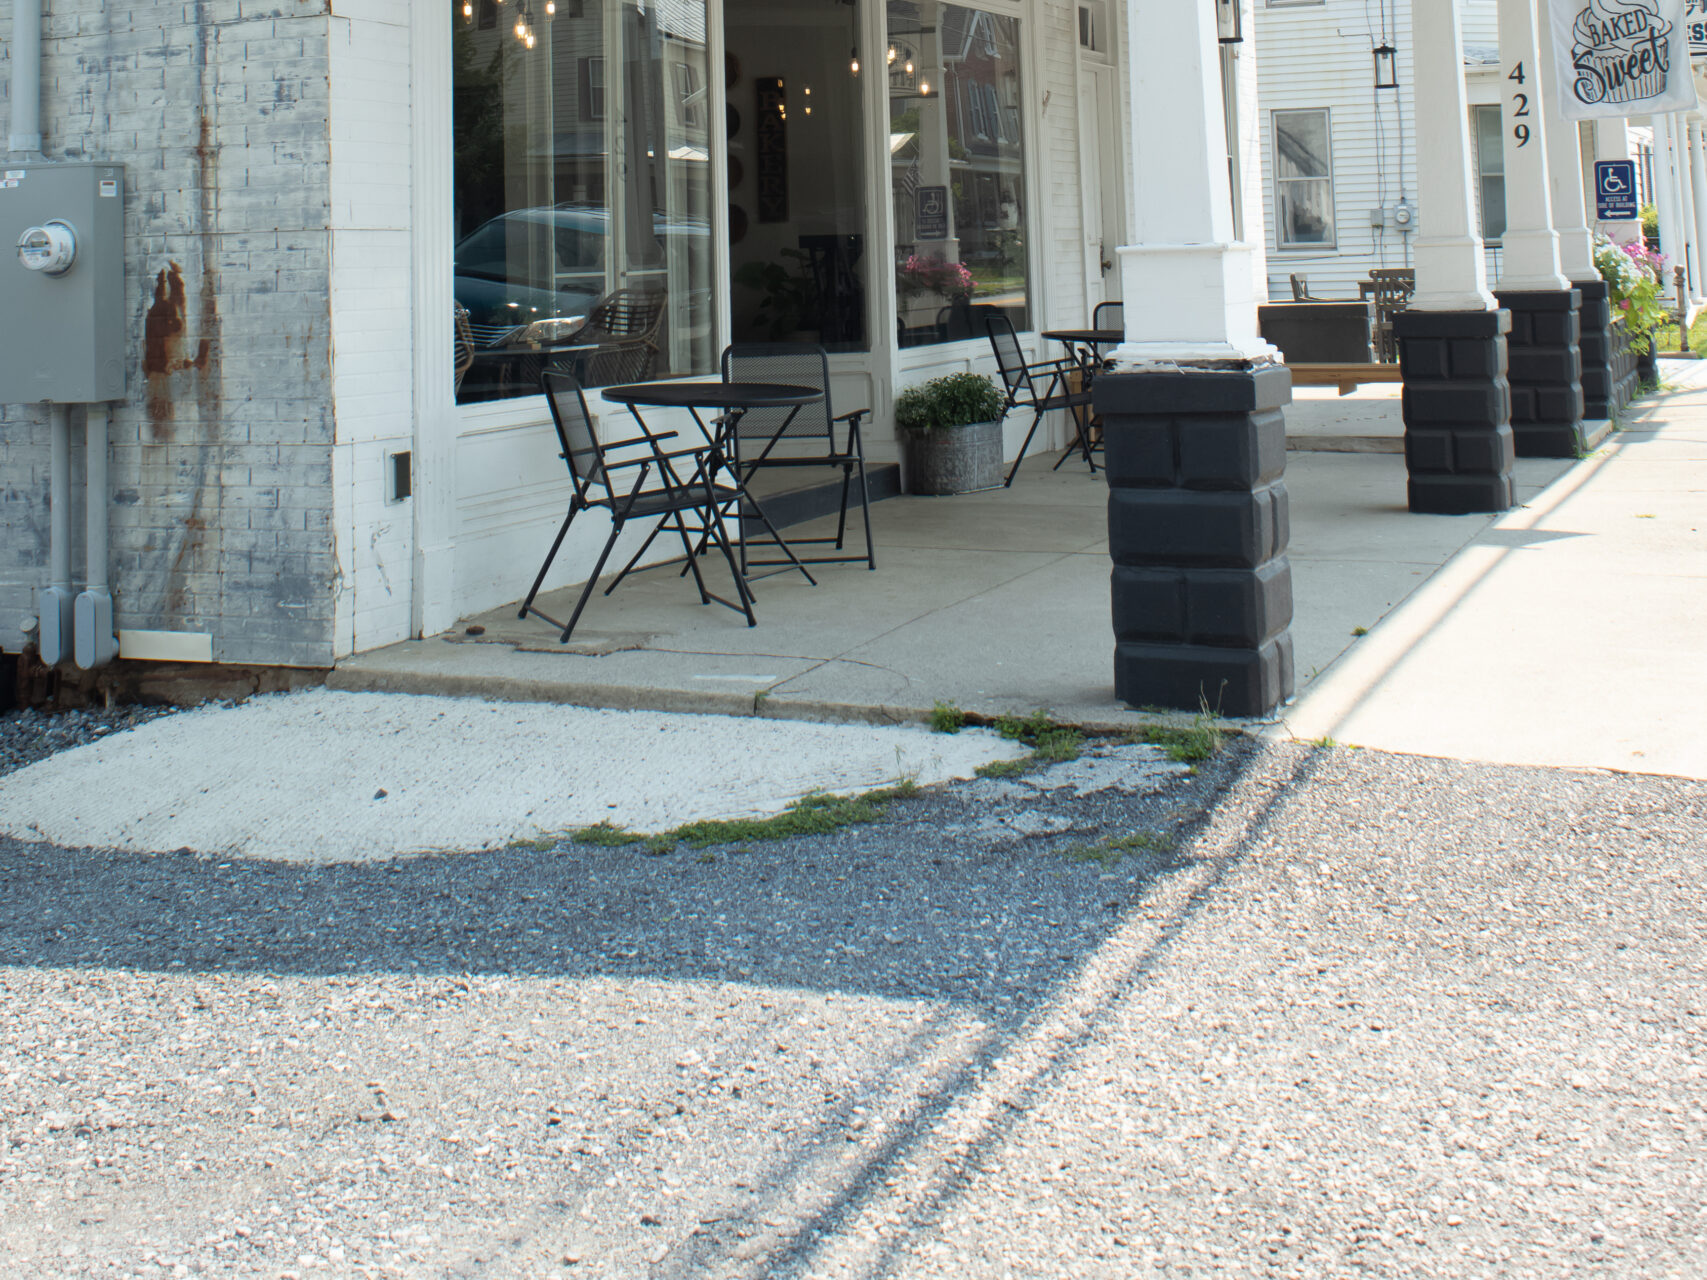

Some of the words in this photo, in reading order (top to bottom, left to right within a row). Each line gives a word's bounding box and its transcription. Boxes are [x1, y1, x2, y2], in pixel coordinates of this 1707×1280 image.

[1573, 20, 1673, 105] Sweet
[1588, 9, 1649, 47] BAKED
[1508, 61, 1530, 148] 429
